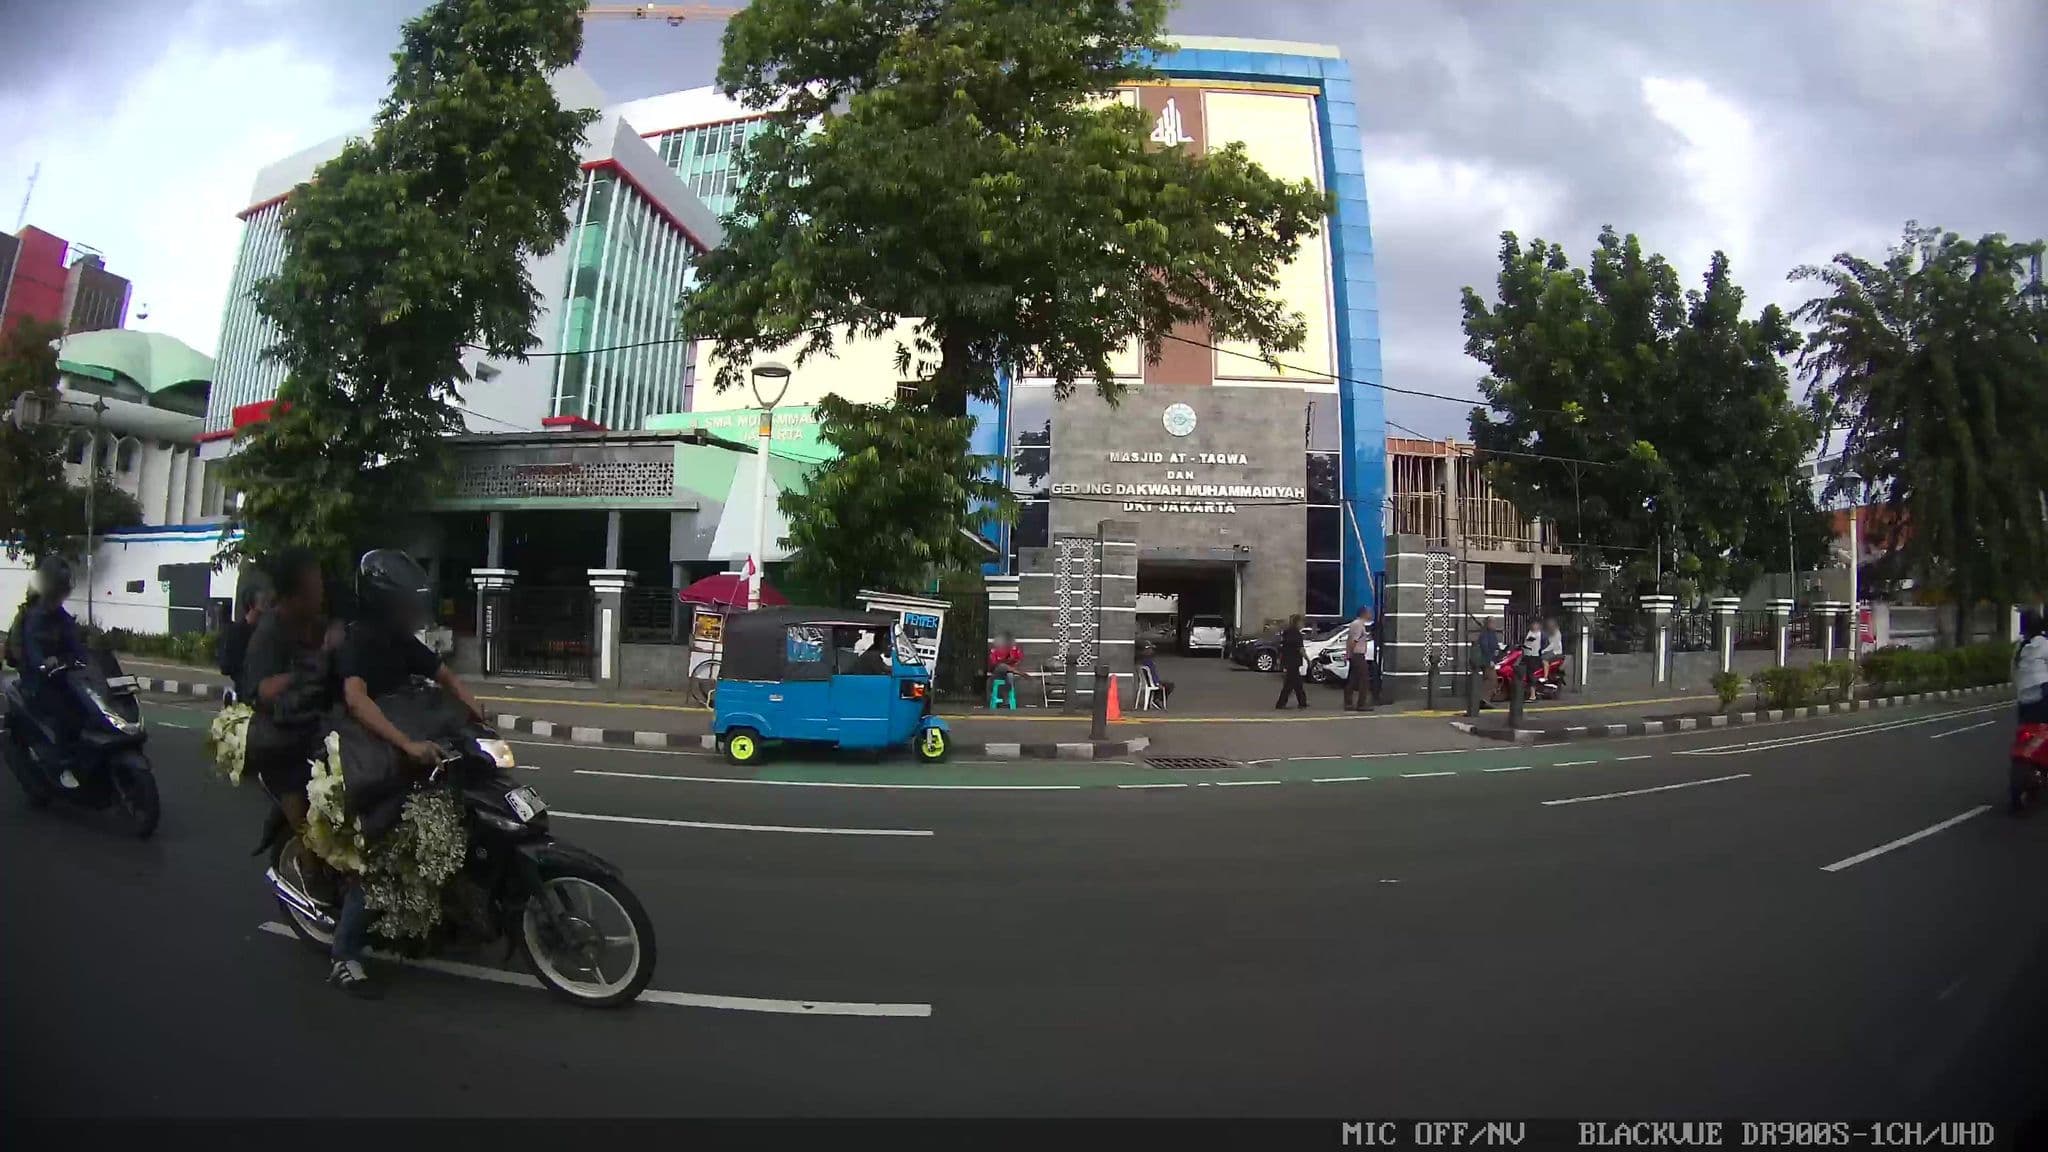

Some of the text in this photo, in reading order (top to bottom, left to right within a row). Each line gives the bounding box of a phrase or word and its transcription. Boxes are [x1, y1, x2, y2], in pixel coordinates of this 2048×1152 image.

[1109, 451, 1163, 463] MASJID
[1170, 453, 1186, 463] AT
[1200, 453, 1248, 465] TAQWA
[1167, 470, 1194, 480] DAN
[1116, 483, 1182, 496] DAKWAH
[1185, 484, 1305, 498] MUHAMMADIYAH
[1123, 500, 1237, 513] DKI JAKARTA
